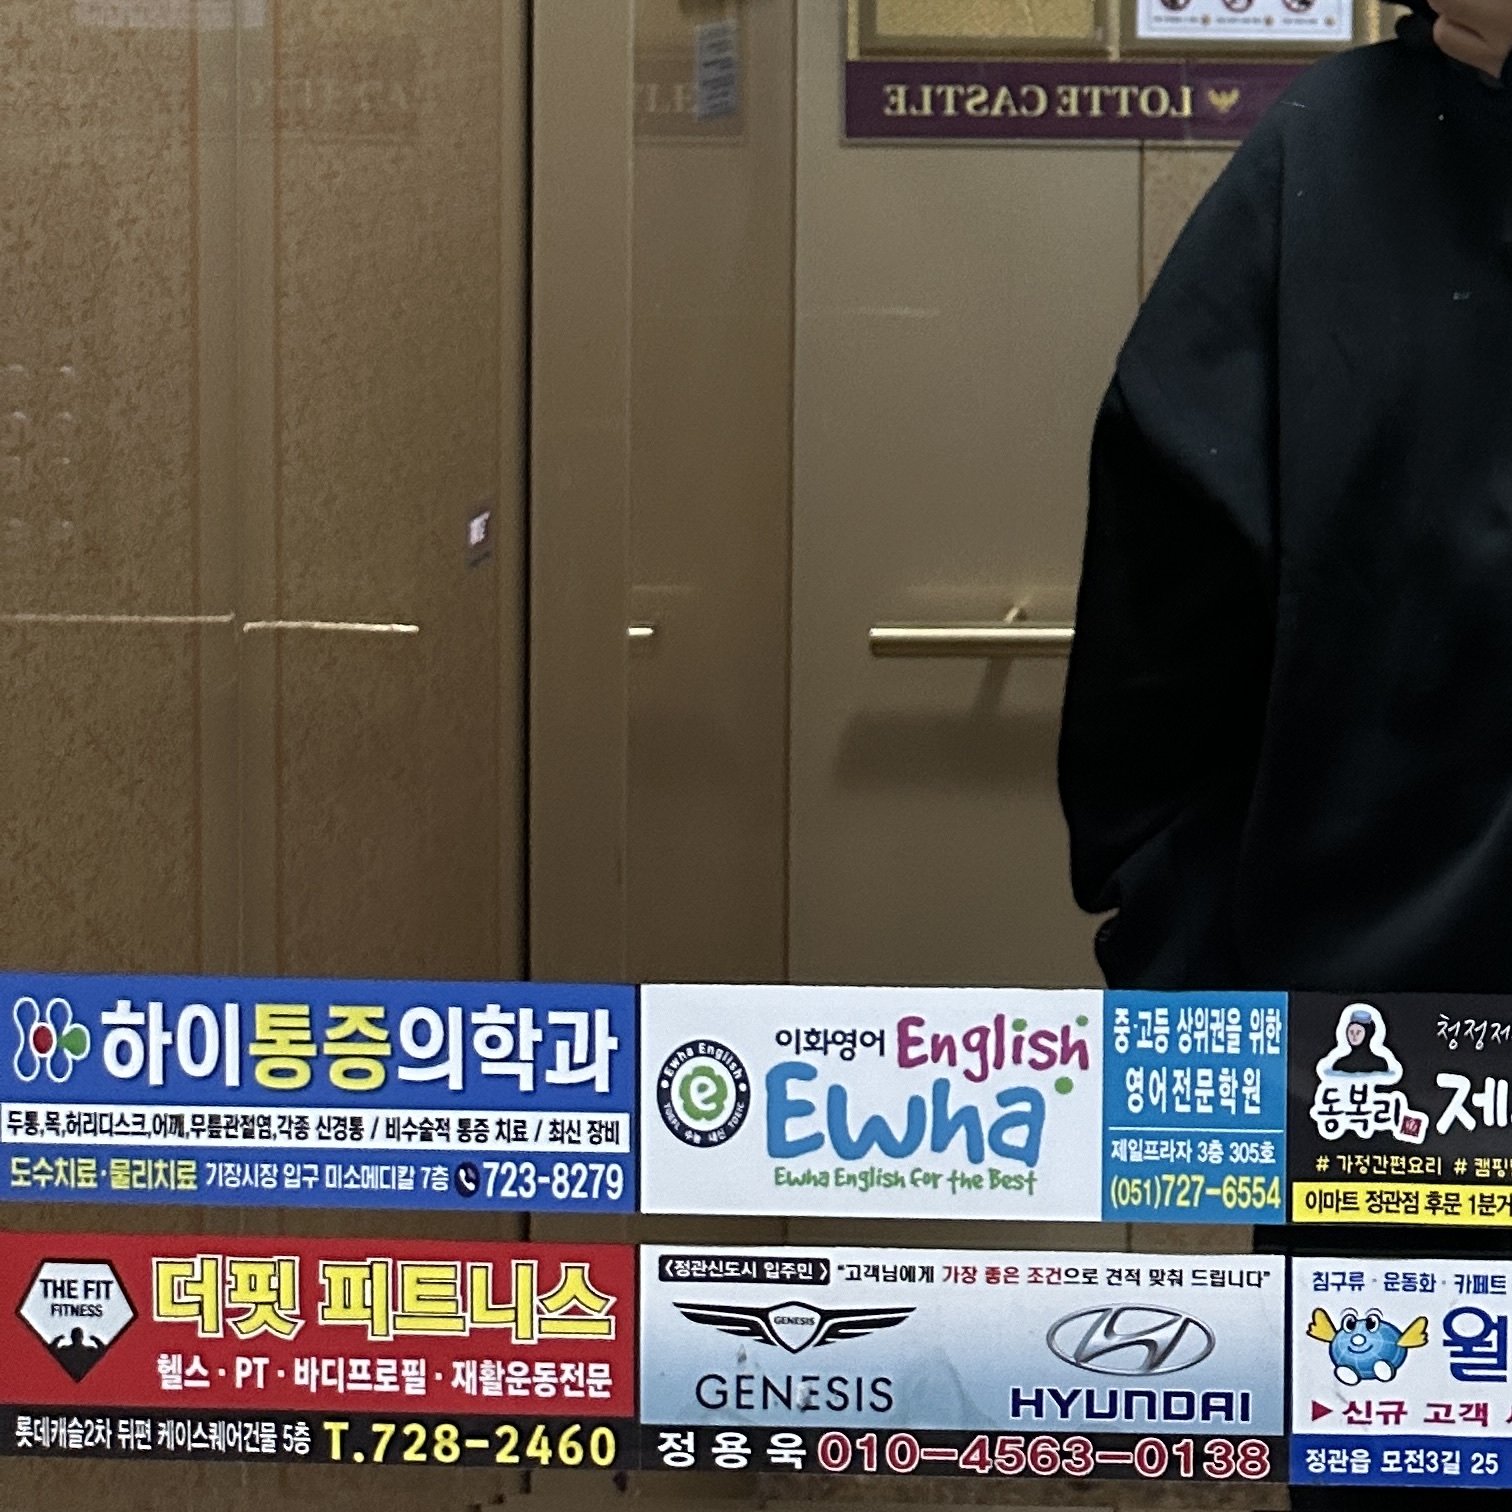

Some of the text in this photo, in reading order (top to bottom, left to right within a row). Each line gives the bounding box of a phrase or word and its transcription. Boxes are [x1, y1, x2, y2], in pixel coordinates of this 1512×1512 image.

[101, 998, 619, 1093] 하이통증의학과
[774, 1012, 1090, 1083] 이화영어 English
[1176, 1006, 1283, 1055] 상위권을 위한
[1125, 1066, 1262, 1116] 영어전문학원
[765, 1061, 1047, 1169] Ewha
[1317, 1080, 1402, 1141] 동복리
[316, 1115, 620, 1145] 신경통 비수술적 통증 치료 최신 장비
[1110, 1138, 1277, 1165] 제일프라자 3층 305호
[1337, 1154, 1443, 1176] 가정간편요리
[206, 1161, 625, 1200] 기장시장 입구 미소메디칼 7층 723-8279
[774, 1166, 1038, 1196] Ewha English for the Best
[1110, 1173, 1282, 1210] (051)727-6554
[1305, 1190, 1361, 1214] 이마트
[1365, 1190, 1420, 1214] 정관점
[1424, 1192, 1462, 1215] 후문
[40, 1279, 112, 1300] THE FIT
[942, 1265, 1184, 1287] 가장 좋은 조건으로 견적 맞춰
[1312, 1271, 1365, 1292] 침구류
[1383, 1272, 1437, 1293] 운동화
[1454, 1274, 1507, 1295] 카페트
[50, 1302, 104, 1318] FITNESS
[153, 1254, 617, 1343] 더핏 피트니스
[774, 1316, 815, 1327] GENESIS
[157, 1353, 613, 1399] 헬스 PT 바디프로필 재활운동전문
[694, 1374, 894, 1413] GENESIS
[1009, 1386, 1252, 1424] HYUNDAI
[1342, 1399, 1408, 1426] 신규
[1424, 1400, 1490, 1429] 고객
[15, 1415, 617, 1468] 롯데캐슬2차 뒤편 케이스퀘어건물 5층 T.728-2460
[815, 1431, 1272, 1479] 010-4563-0138
[1305, 1450, 1372, 1474] 정관읍
[1380, 1450, 1462, 1475] 모전3길
[1470, 1453, 1499, 1475] 25
